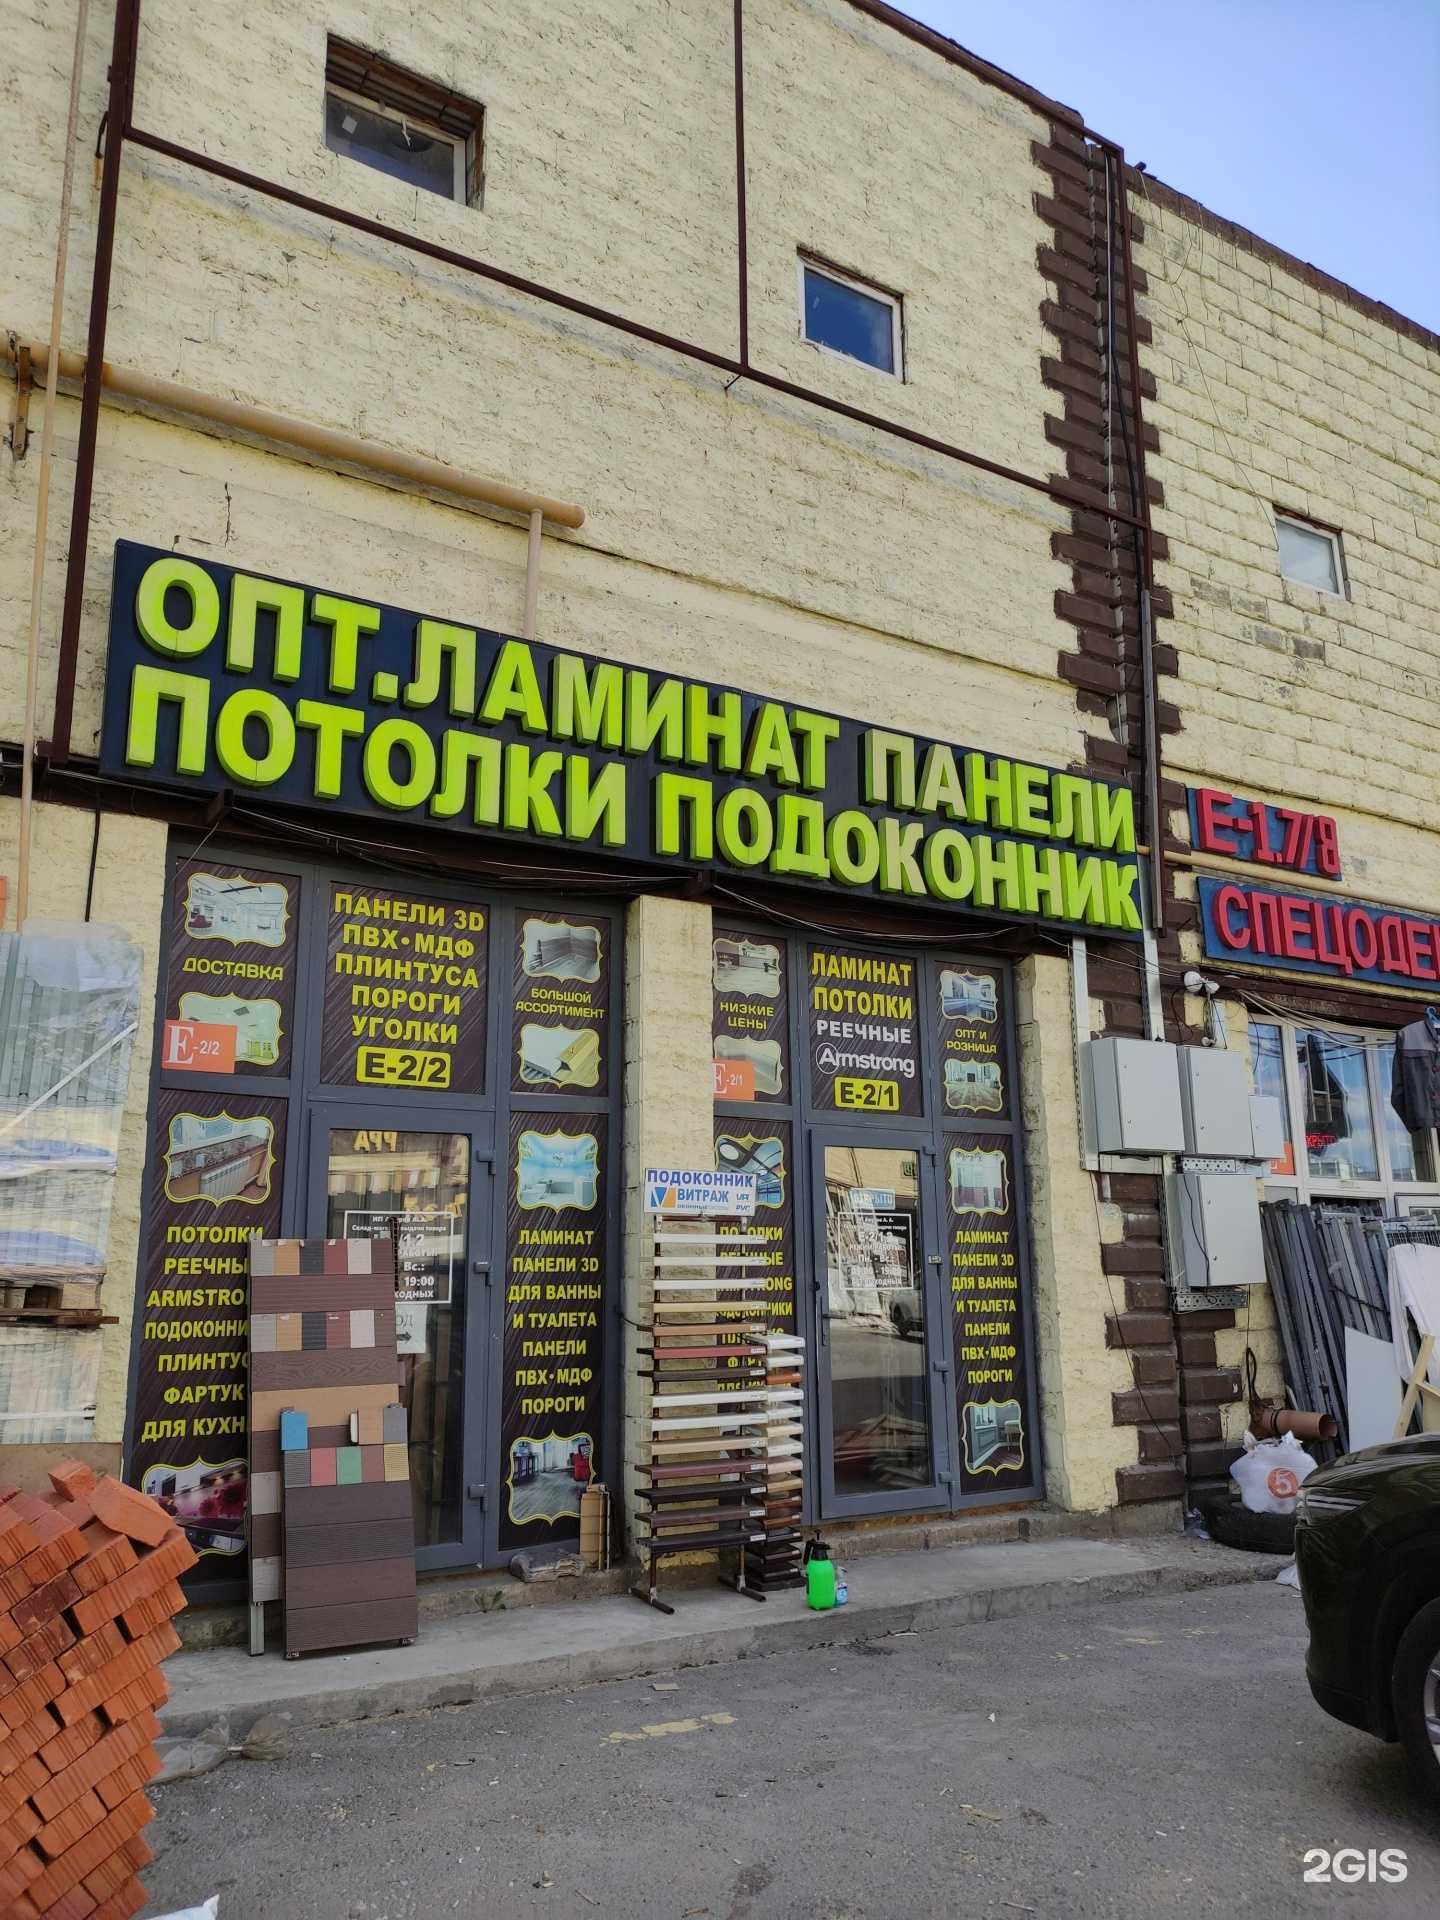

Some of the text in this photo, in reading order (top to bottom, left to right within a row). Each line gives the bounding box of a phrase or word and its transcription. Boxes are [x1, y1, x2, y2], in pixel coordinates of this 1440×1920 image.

[126, 664, 1142, 931] ПОТОЛКИ ПОДОКОННИК
[865, 729, 1136, 854] ПАНЕЛИ
[334, 892, 485, 932] ПАНЕЛИ 3D
[1214, 885, 1440, 980] СПЕЦОДЕ
[182, 957, 284, 981] ДОСТАВКА
[335, 952, 479, 989] ПЛИНТУСА
[811, 952, 912, 986] ЛАМИНАТ
[351, 984, 461, 1016] ПОРОГИ
[531, 987, 592, 1004] БОЛЬШОЙ
[813, 986, 913, 1020] ПОТОЛКИ
[515, 1001, 605, 1019] АССОРТИМЕНТ
[719, 1002, 775, 1017] НИЗКИЕ
[351, 1015, 458, 1045] УГОЛКИ
[727, 1016, 768, 1030] ЦЕНЫ
[816, 1020, 912, 1044] РЕЕЧНЫЕ
[955, 1028, 977, 1039] ОПТ
[946, 1040, 997, 1054] РОЗНИЦА
[817, 1045, 915, 1078] Armstrong
[647, 1170, 754, 1187] ПОДОКОННИК
[677, 1189, 729, 1202] ВИТРАЖ
[166, 1226, 264, 1243] ПОТОЛКИ
[518, 1229, 594, 1246] ЛАМИНАТ
[720, 1227, 783, 1240] ПООЛКИ
[955, 1231, 1009, 1244] ЛАМИНАТ
[163, 1257, 248, 1275] РЕЕЧНЫ
[512, 1257, 599, 1273] ПАНЕЛИ 3D
[952, 1253, 1014, 1267] ПАНЕЛИ 3D
[404, 1276, 434, 1286] 19:00
[952, 1276, 1018, 1291] ДЛЯ ВАННЫ
[146, 1289, 245, 1307] ARMSTRO
[508, 1283, 601, 1303] ДЛЯ ВАННЫ
[956, 1299, 1016, 1313] И ТУАЛЕТА
[512, 1312, 597, 1329] И ТУАЛЕТА
[964, 1322, 1011, 1337] ПАНЕЛИ
[144, 1319, 248, 1342] ПОДОКОННИ
[522, 1339, 587, 1357] ПАНЕЛИ
[157, 1351, 248, 1372] ПЛИНТУС
[967, 1369, 1013, 1384] ПОРОГИ
[163, 1385, 245, 1405] ФАРТУК
[521, 1395, 585, 1415] ПОРОГИ
[141, 1415, 245, 1443] ДЛЯ КУХН
